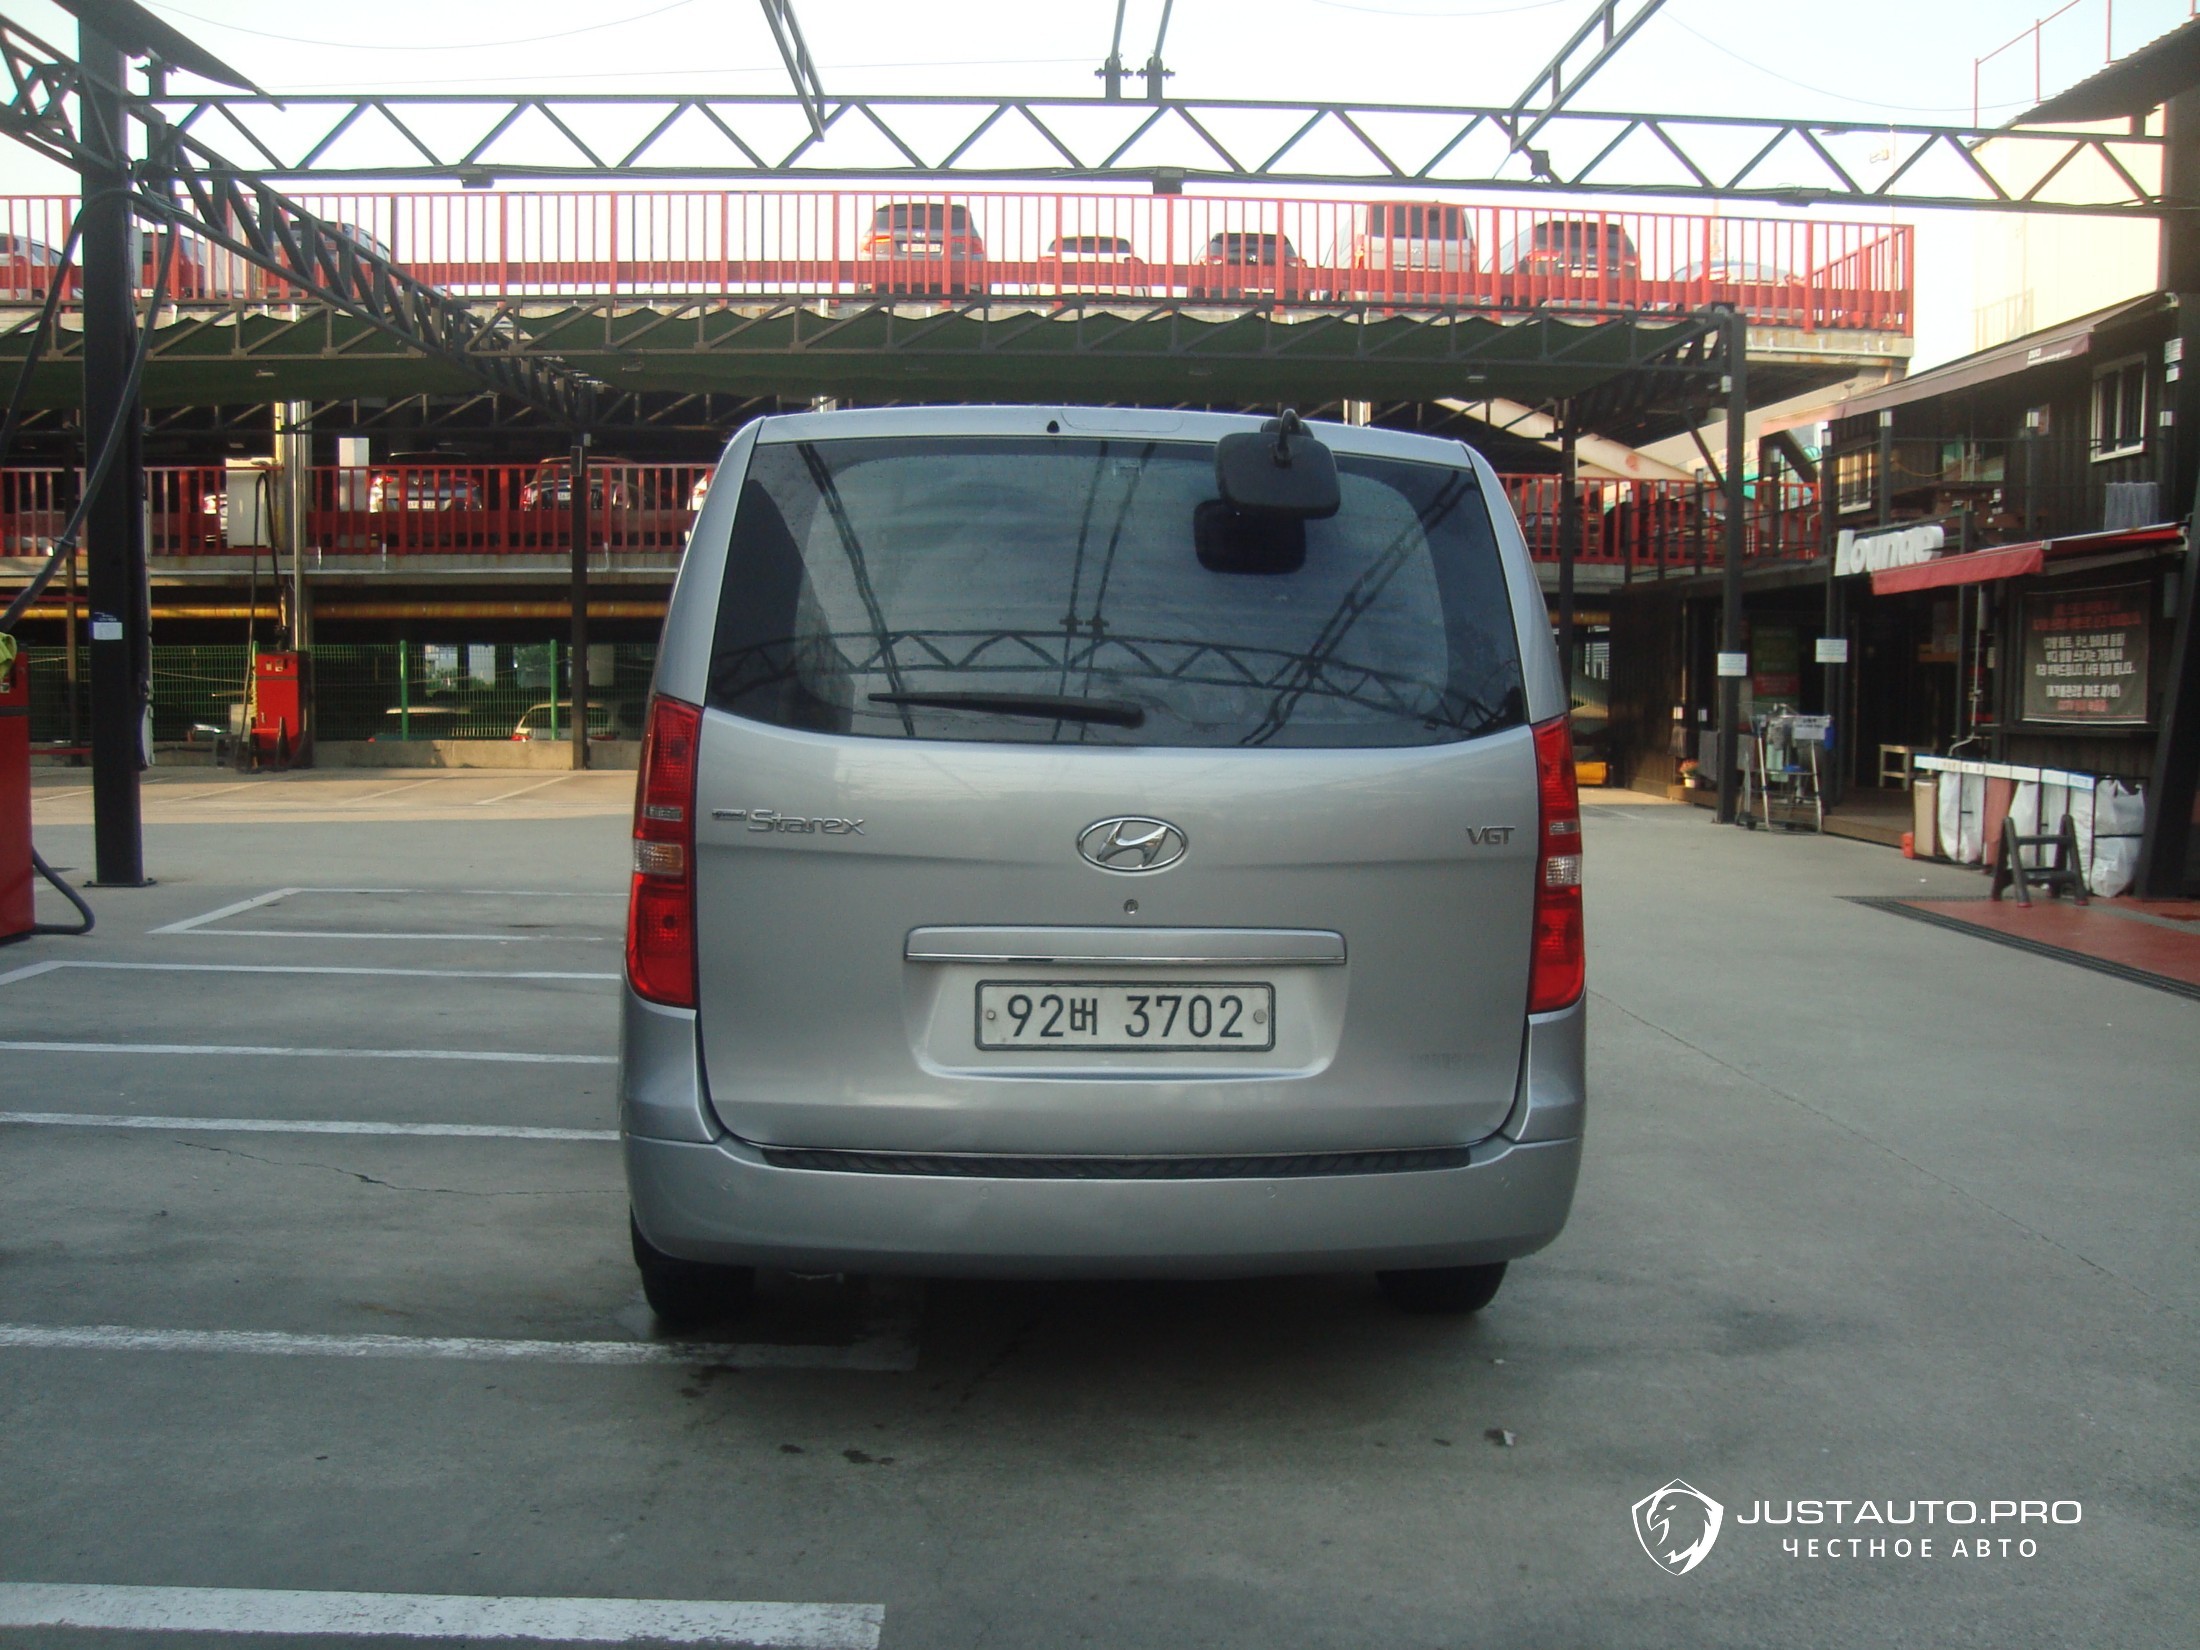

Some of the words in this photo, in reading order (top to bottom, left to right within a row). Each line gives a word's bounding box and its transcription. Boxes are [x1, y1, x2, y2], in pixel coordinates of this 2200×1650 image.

[748, 809, 865, 836] Starex
[1465, 825, 1516, 845] VGT
[1124, 995, 1243, 1037] 3702
